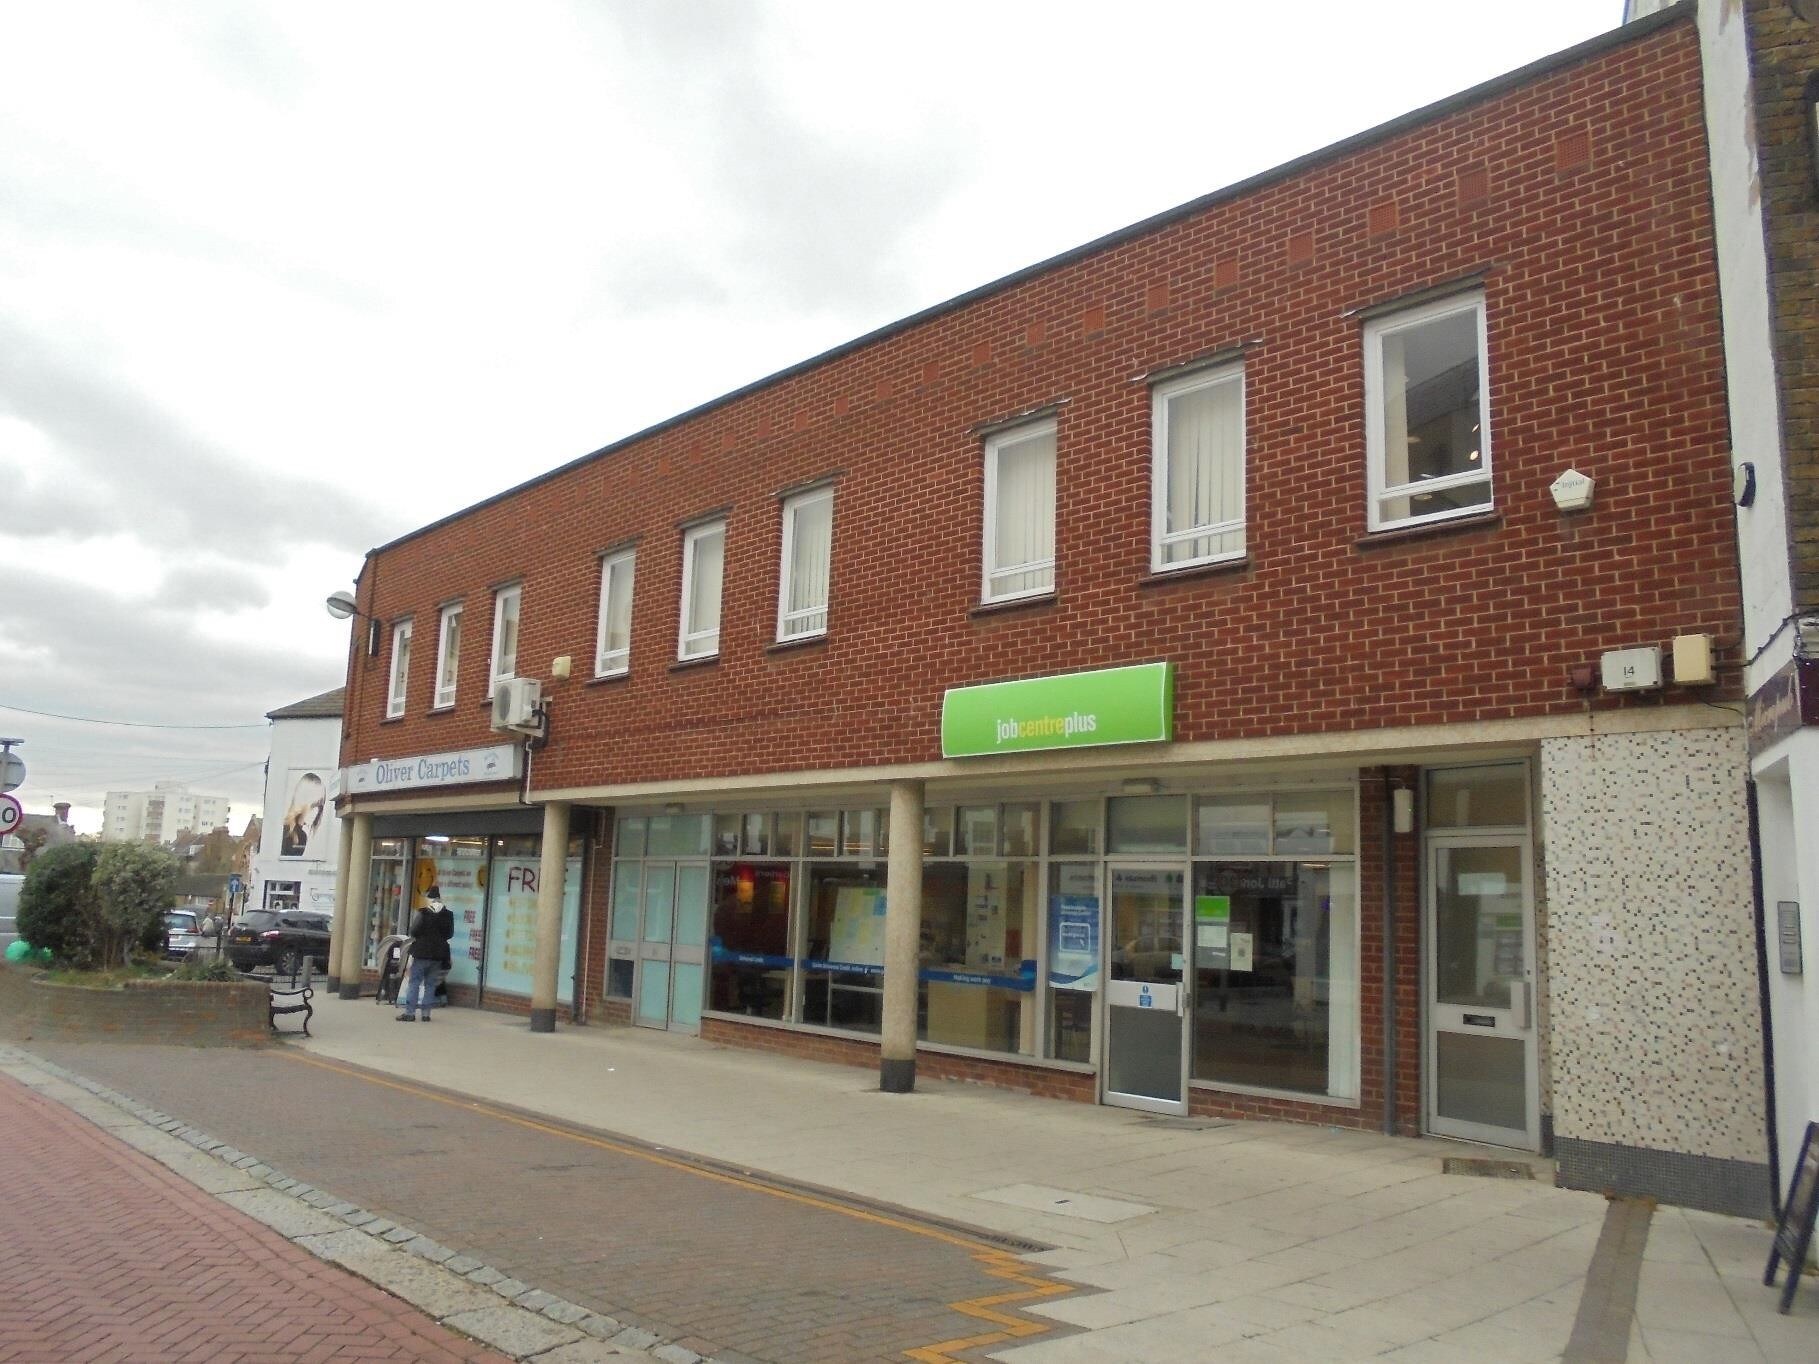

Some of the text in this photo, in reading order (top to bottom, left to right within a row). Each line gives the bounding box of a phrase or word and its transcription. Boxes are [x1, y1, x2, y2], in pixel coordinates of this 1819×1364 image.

[1622, 665, 1635, 677] 14
[995, 711, 1097, 744] jobcentreplus
[376, 762, 413, 785] Oliver
[418, 757, 471, 781] Carpets
